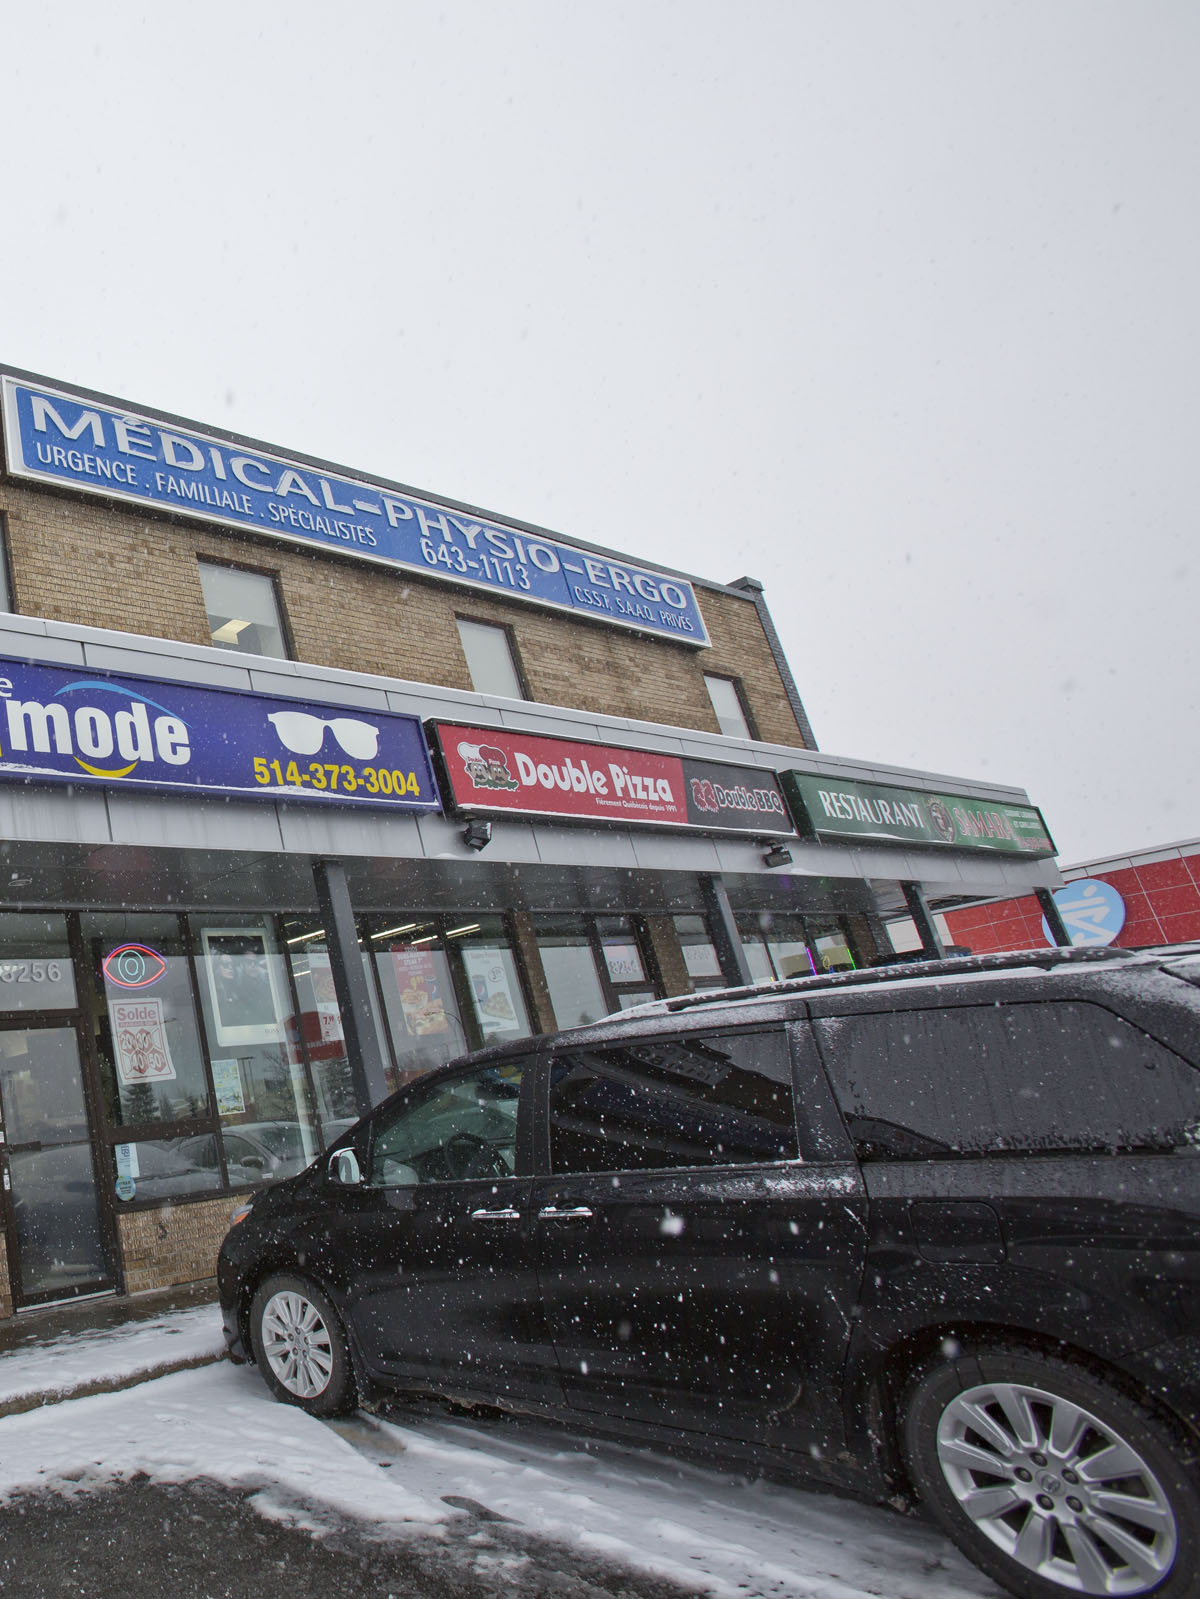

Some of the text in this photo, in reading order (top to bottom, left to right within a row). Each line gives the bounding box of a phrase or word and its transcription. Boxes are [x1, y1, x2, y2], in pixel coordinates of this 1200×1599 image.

[37, 442, 138, 486] URGENCE
[155, 472, 254, 515] FAMILIALE
[268, 502, 377, 548] SPÉCIALISTES
[420, 537, 531, 590] 643-1113
[253, 757, 421, 797] 514-373-3004
[513, 752, 675, 802] Double Pizza
[818, 789, 926, 829] RESTAURANT
[953, 807, 1016, 840] SAMARA
[0, 961, 62, 984] 8256
[117, 1006, 157, 1021] Solde
